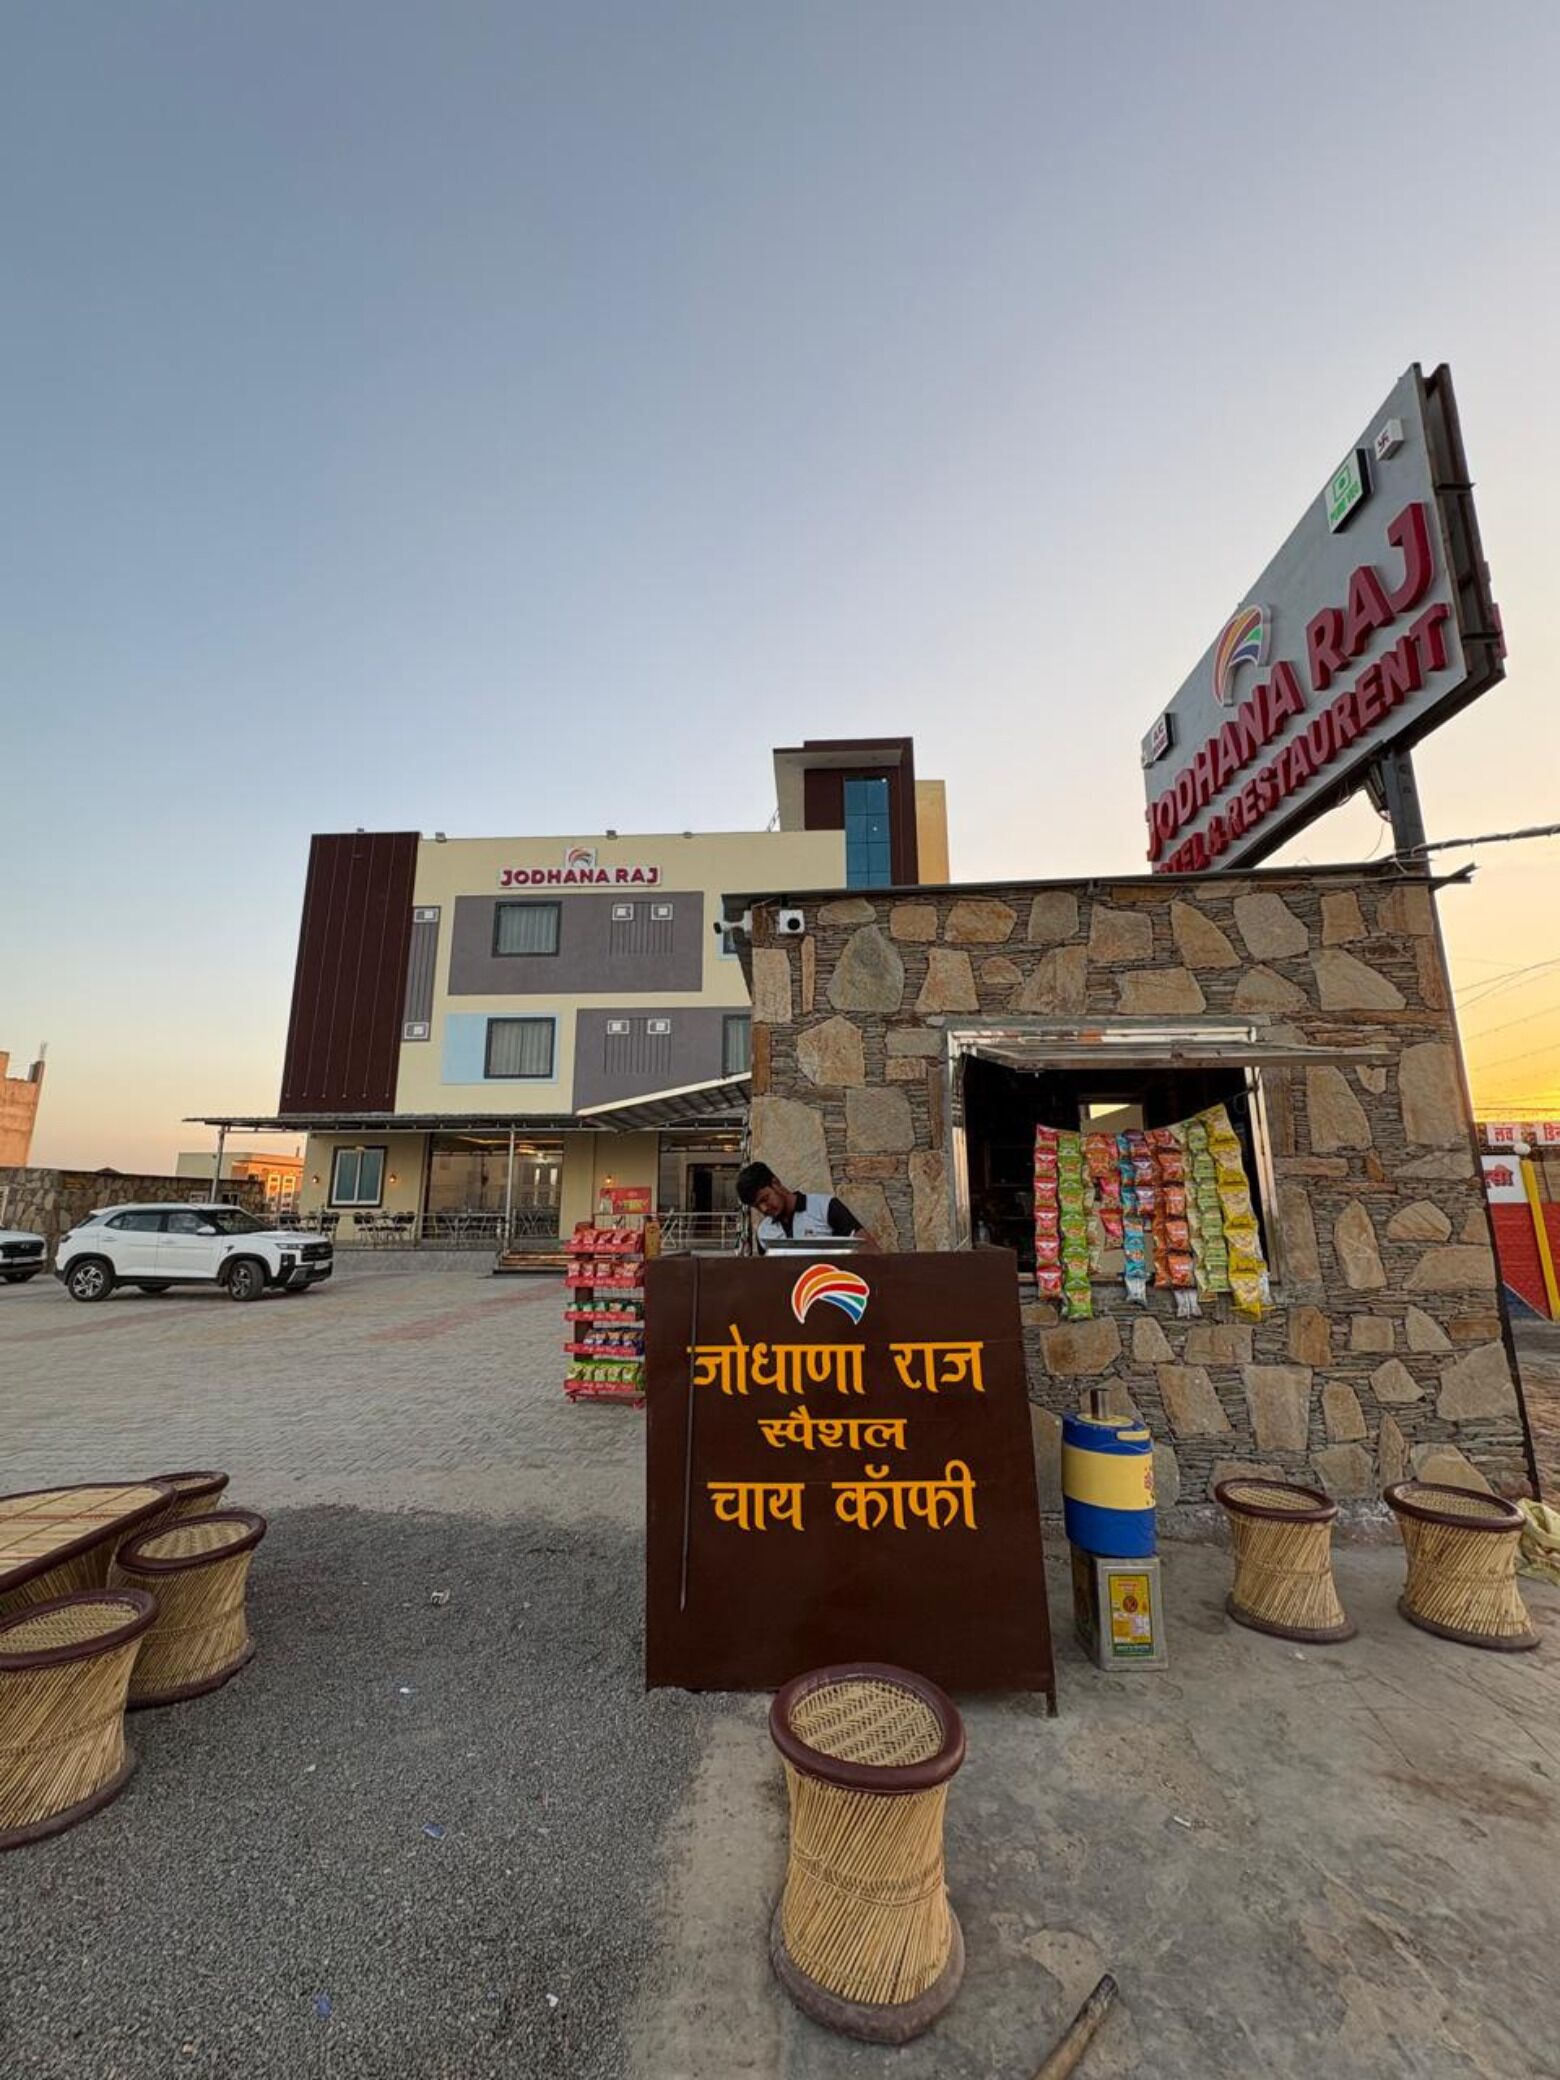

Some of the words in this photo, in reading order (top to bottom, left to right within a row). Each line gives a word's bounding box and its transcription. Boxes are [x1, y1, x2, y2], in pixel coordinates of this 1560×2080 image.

[1146, 660, 1306, 861] JODHANA
[1306, 502, 1433, 690] RAJ
[1226, 603, 1449, 841] RESTAURENT
[500, 868, 611, 886] JODHANA
[615, 866, 659, 884] RAJ
[687, 1324, 867, 1395] जोधाणा
[889, 1341, 985, 1393] राज
[706, 1481, 805, 1531] चाय
[831, 1458, 978, 1530] कॉफी
